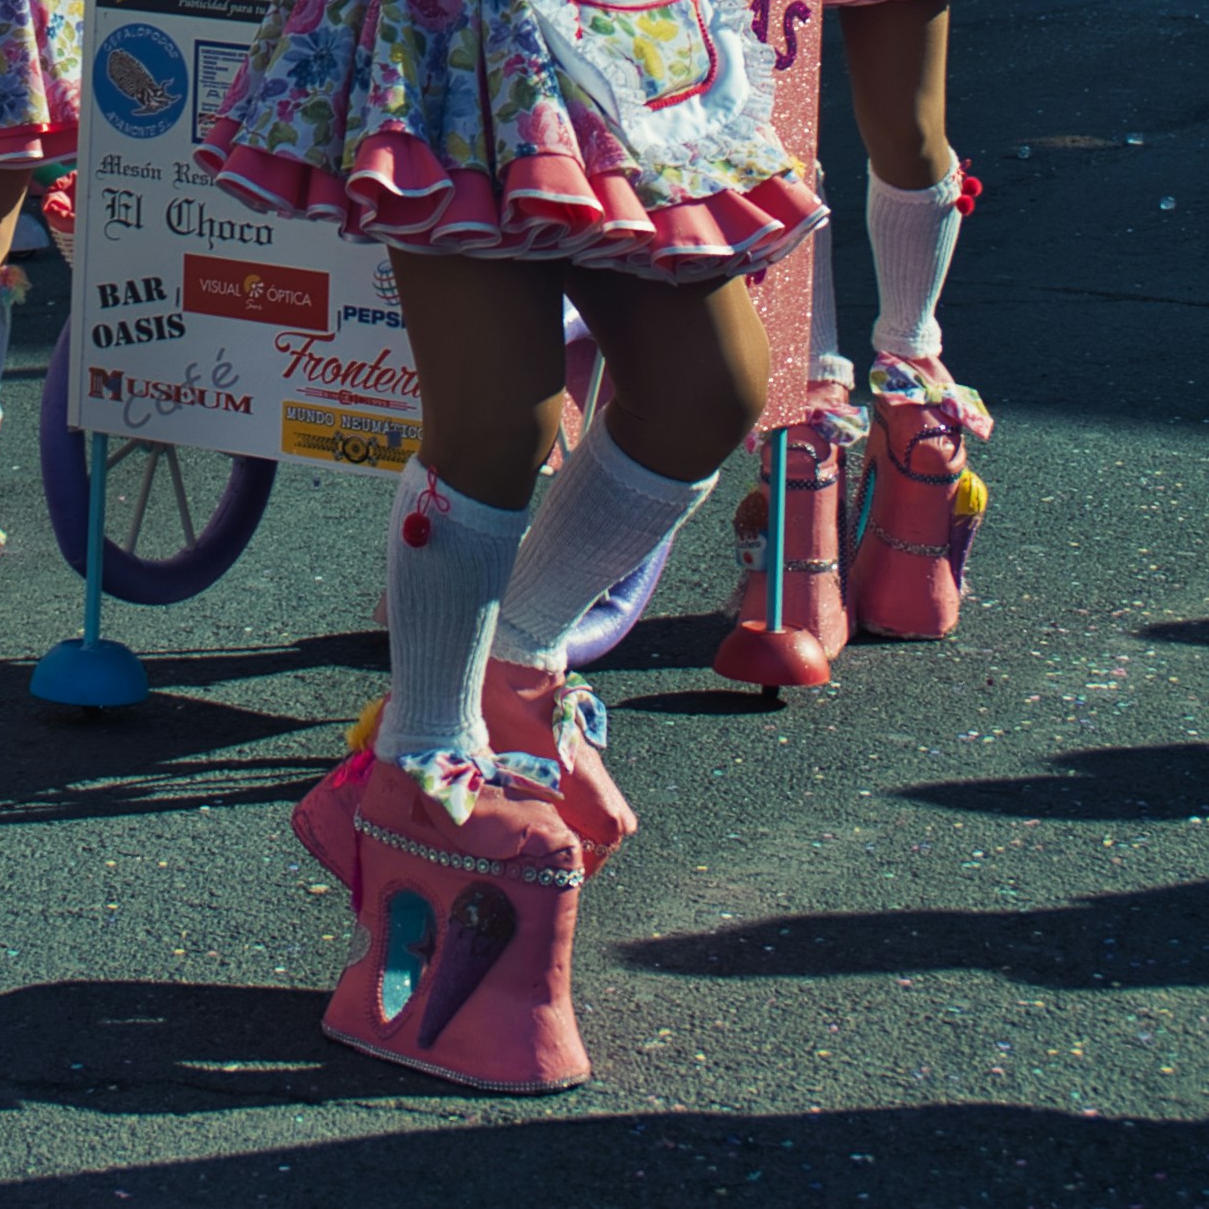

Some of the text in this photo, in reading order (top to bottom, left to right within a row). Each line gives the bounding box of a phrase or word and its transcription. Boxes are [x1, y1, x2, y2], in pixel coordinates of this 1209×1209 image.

[227, 2, 254, 17] para
[95, 153, 162, 181] Mesón
[101, 188, 274, 250] El Choco
[97, 276, 168, 309] BAR
[199, 278, 242, 298] VISUAL
[266, 284, 313, 307] ÓPTICA
[92, 312, 186, 349] OASIS
[286, 405, 335, 427] MUNDO
